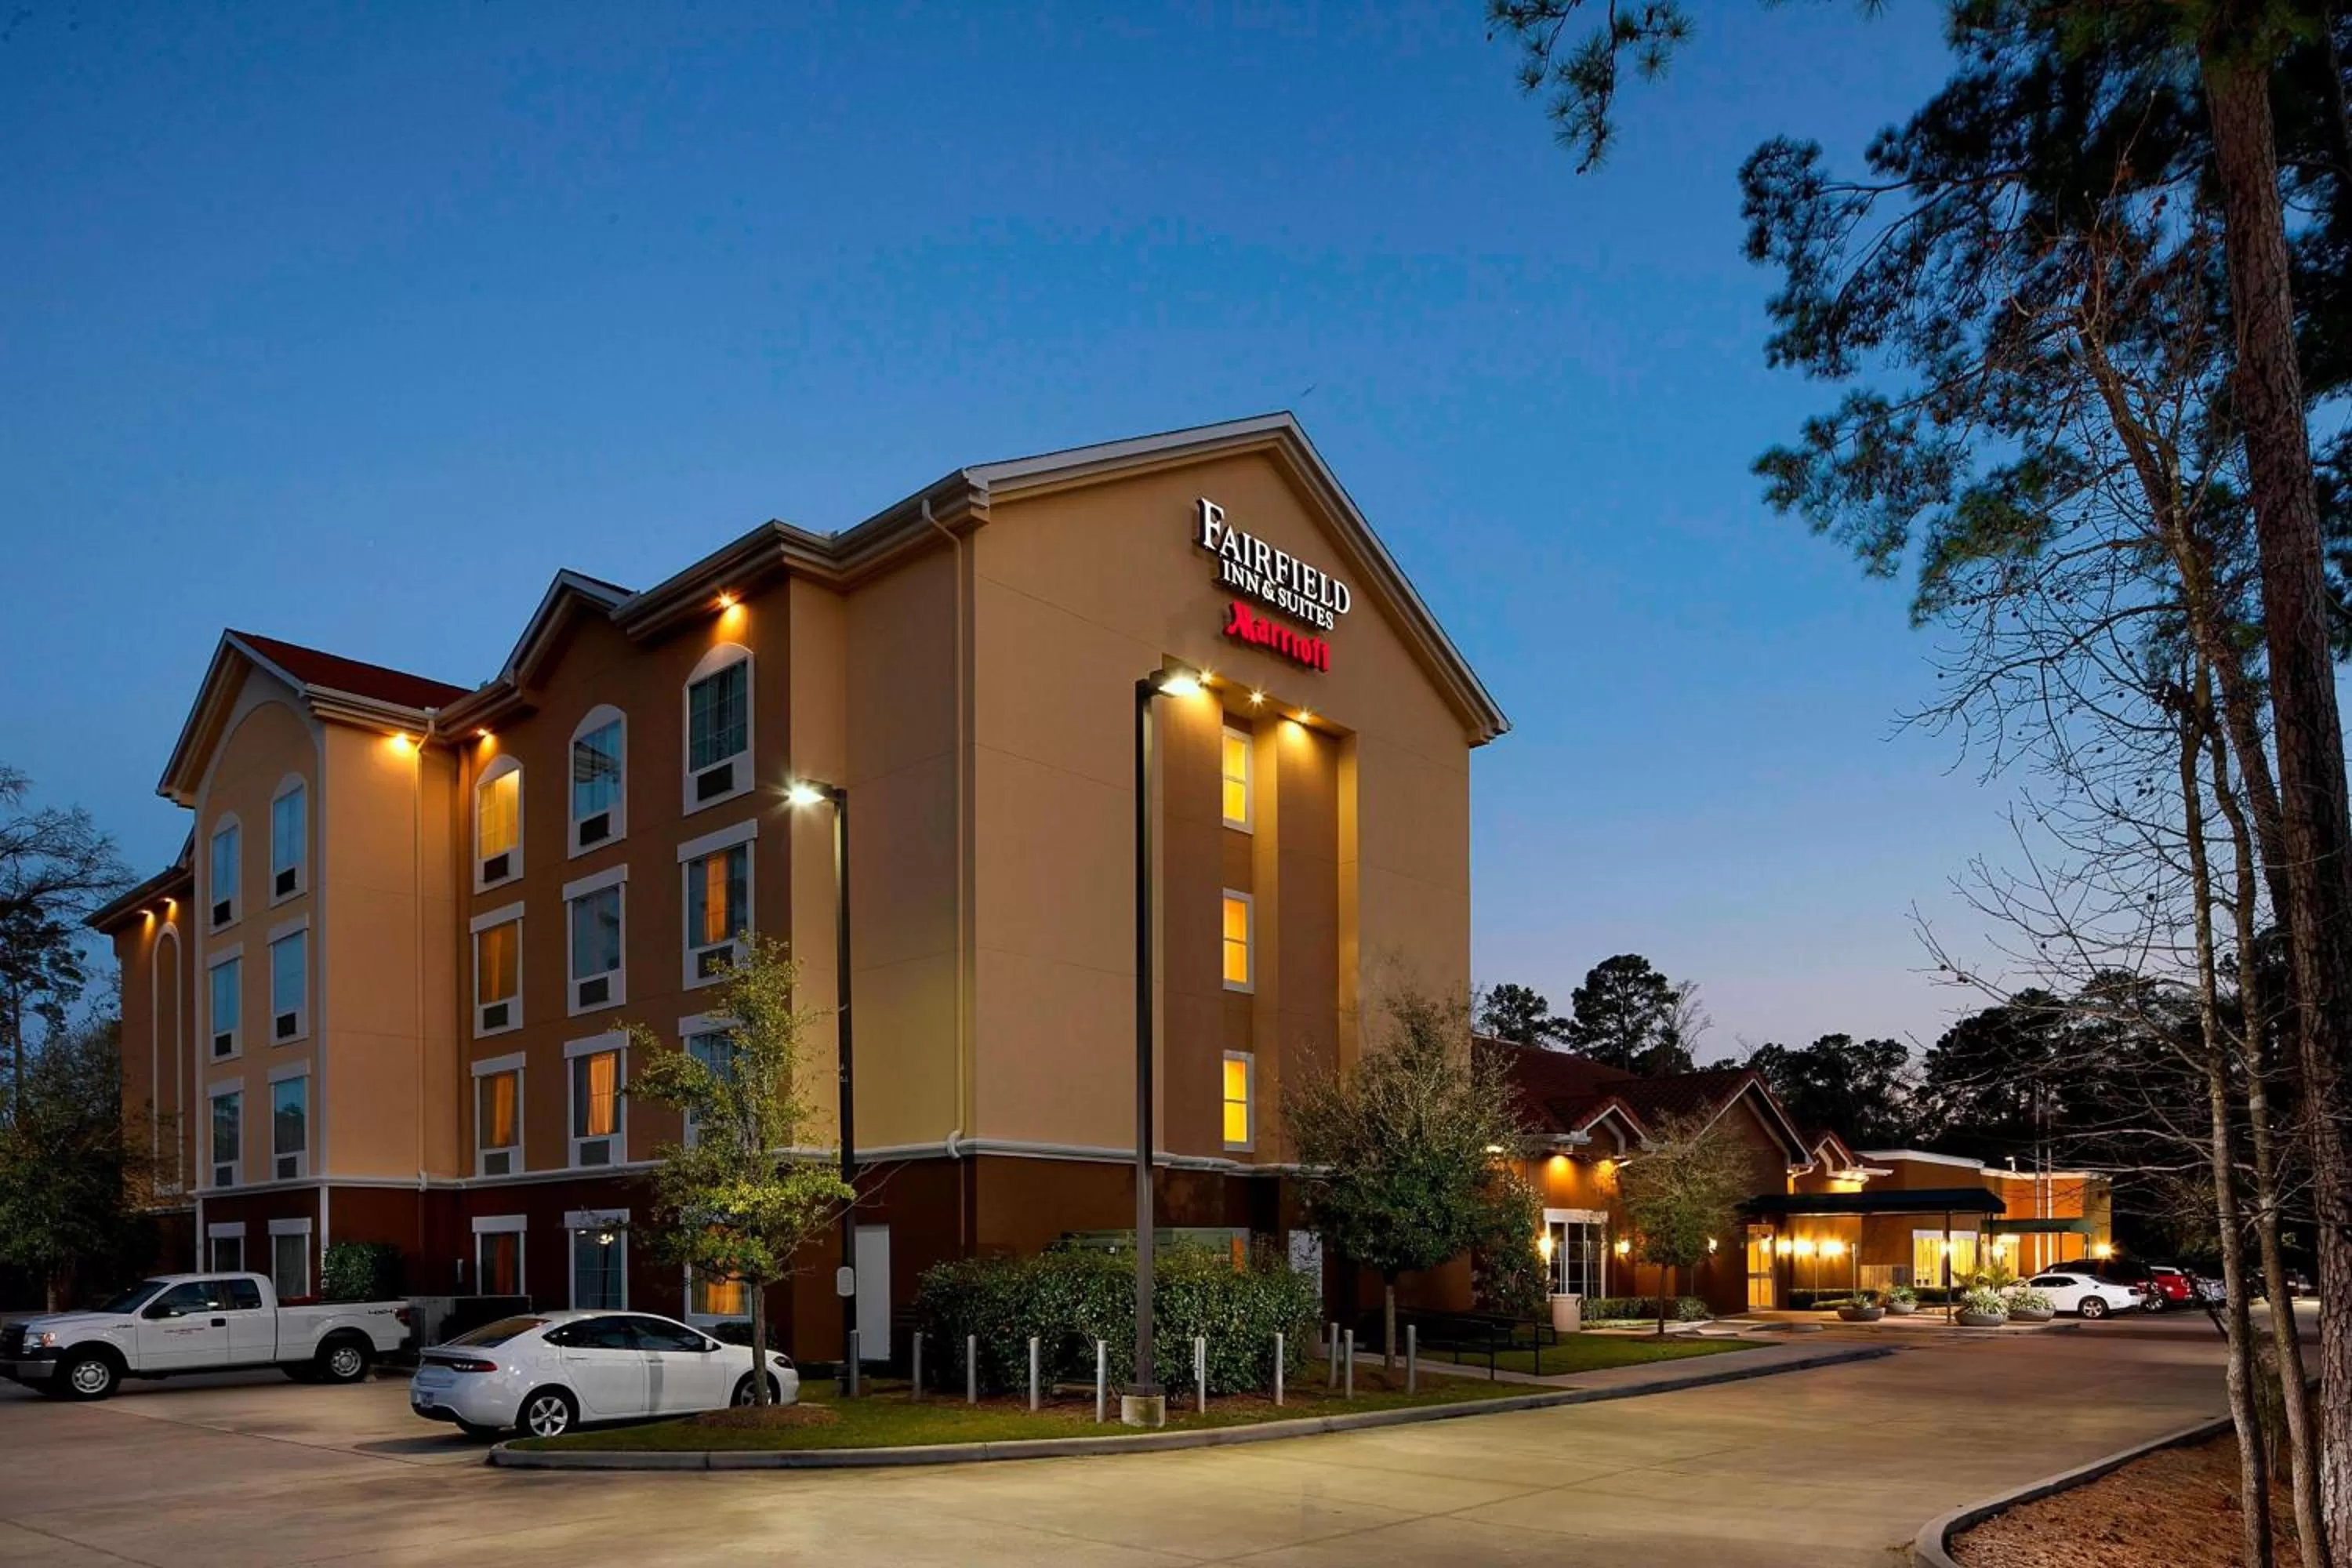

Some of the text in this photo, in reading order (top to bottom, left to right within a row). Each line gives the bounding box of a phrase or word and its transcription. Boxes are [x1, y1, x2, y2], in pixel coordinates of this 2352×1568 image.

[1200, 498, 1351, 614] FAIRFIELD
[1223, 560, 1334, 630] INN & SUITES
[1225, 601, 1330, 673] Marriott
